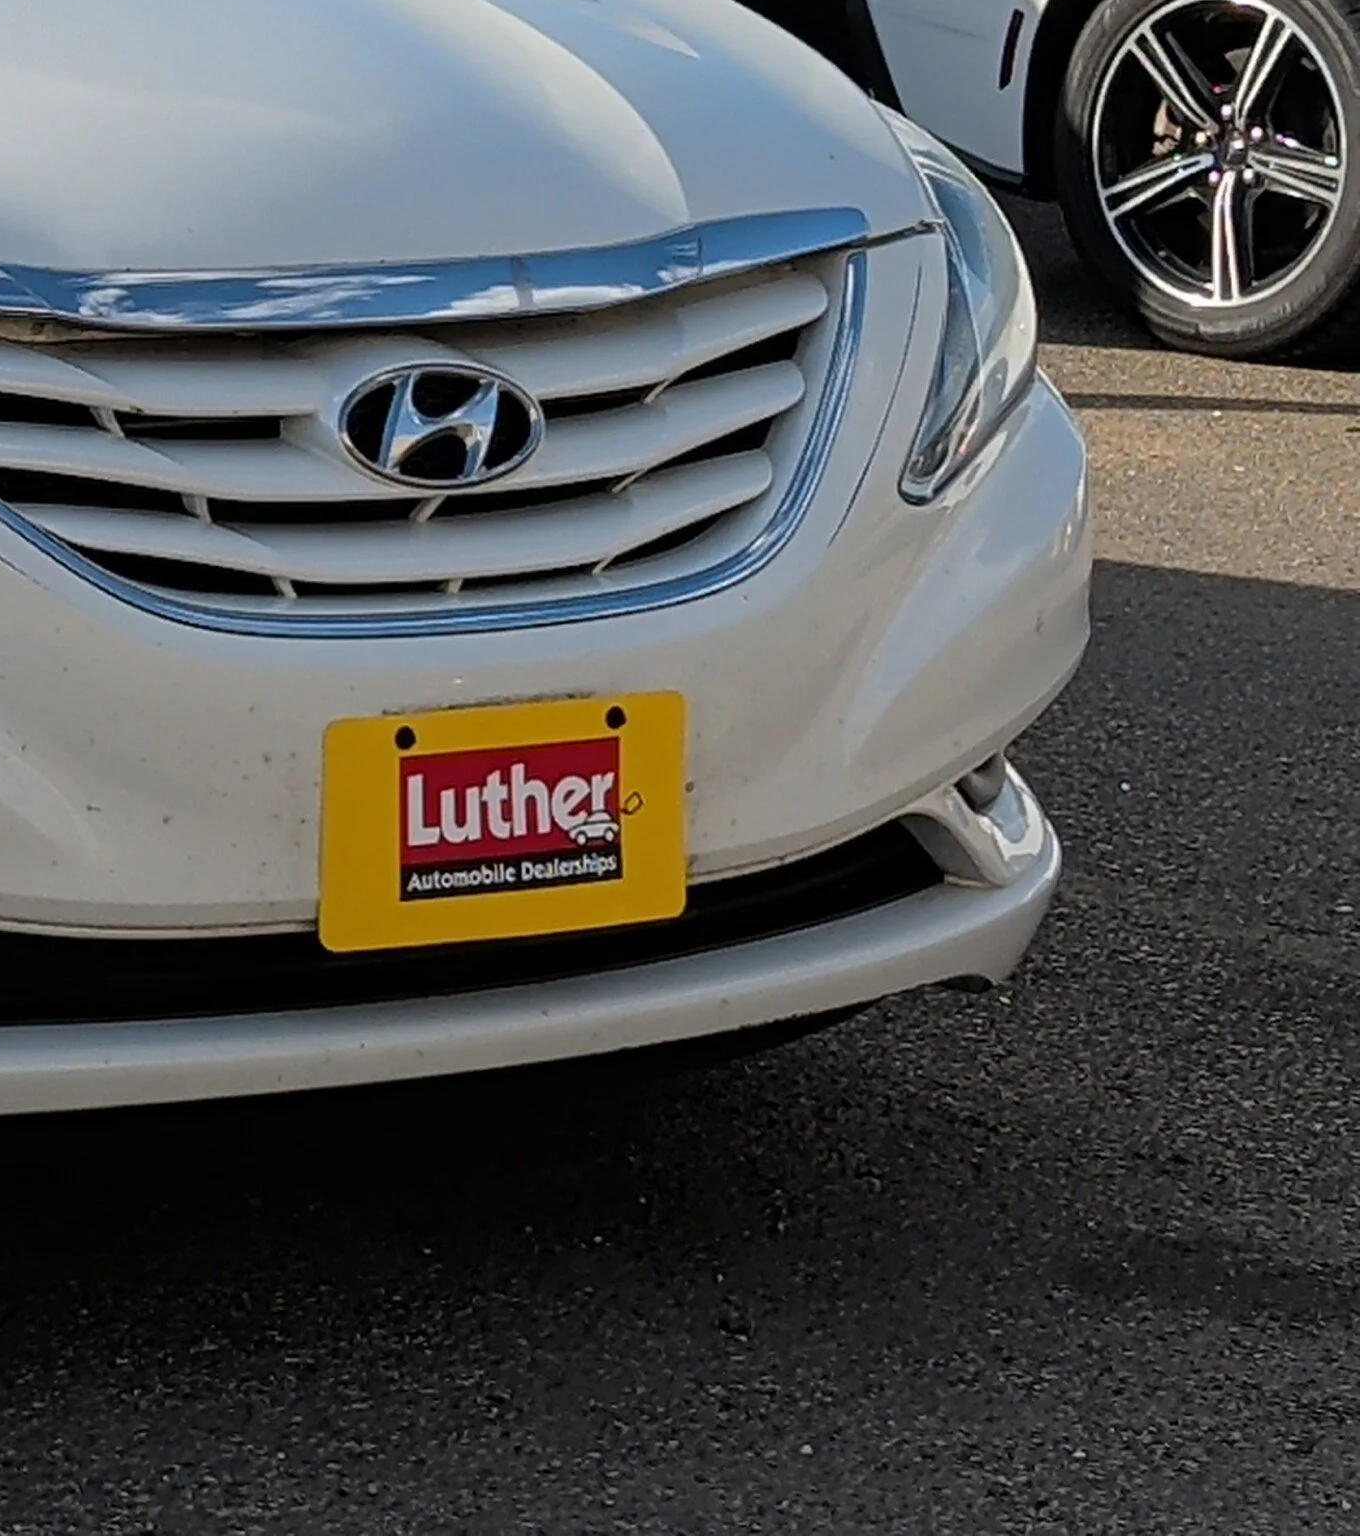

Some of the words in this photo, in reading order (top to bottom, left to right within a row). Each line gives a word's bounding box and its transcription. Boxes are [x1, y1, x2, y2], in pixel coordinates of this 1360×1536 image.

[406, 762, 615, 848] Luther
[406, 862, 516, 893] Automobile
[520, 853, 618, 884] Dealerships
